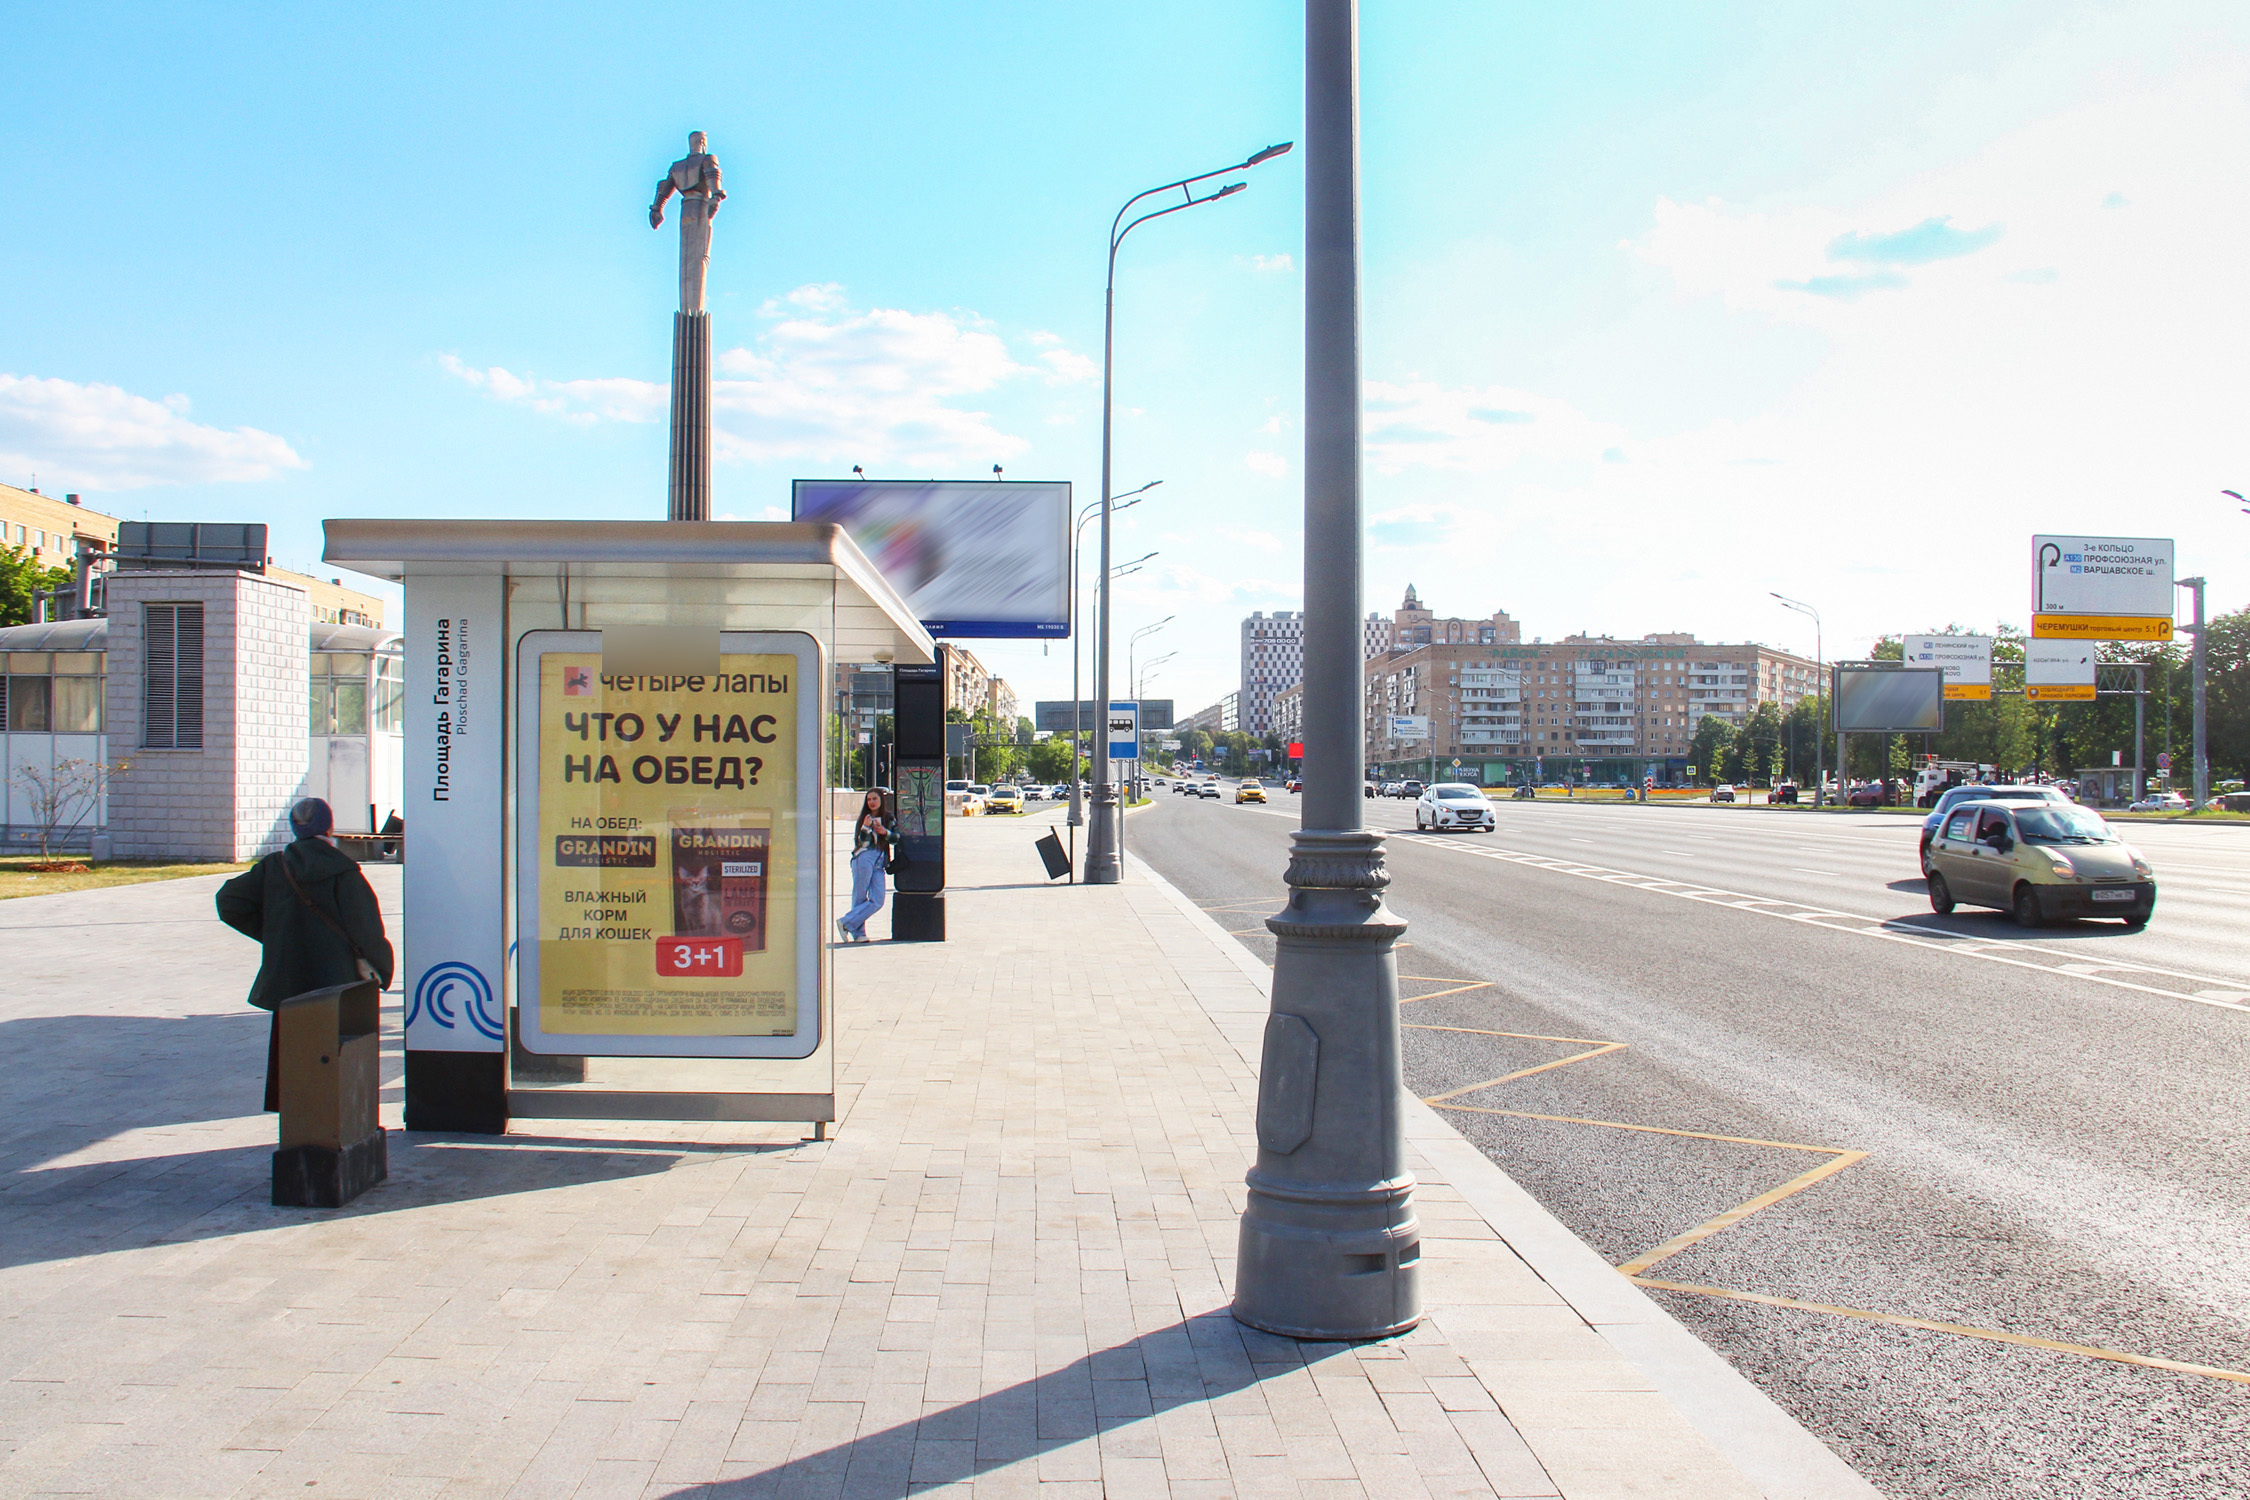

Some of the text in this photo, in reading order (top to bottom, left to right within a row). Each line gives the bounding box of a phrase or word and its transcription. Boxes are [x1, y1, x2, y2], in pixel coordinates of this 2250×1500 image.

[2098, 544, 2134, 553] КОЛЬЦО
[2083, 555, 2153, 564] ПРОФСОЮЗНАЯ
[2154, 558, 2167, 566] ул.
[2083, 566, 2144, 575] ВАРШАВСКОЕ
[2037, 623, 2089, 631] ЧЕРЕМУШКИ
[2090, 626, 2122, 634] торговый
[1492, 647, 1539, 659] РАЙОН
[457, 618, 470, 735] Ploschad Gagarina
[713, 673, 788, 693] лапы
[434, 618, 453, 801] Площадь Гагарина
[565, 712, 777, 744] ЧТО У НАС
[565, 754, 763, 790] НА ОБЕД?
[571, 817, 642, 831] НА ОБЕД:
[560, 840, 652, 856] GRANDIN
[679, 834, 763, 848] GRANDIN
[724, 866, 758, 874] STERILIZED
[565, 889, 647, 904] ВЛАЖНЫЙ
[725, 887, 756, 899] LAMB
[584, 909, 627, 921] КОРМ
[559, 927, 652, 941] ДЛЯ КОШЕК
[674, 945, 724, 969] 3+1
